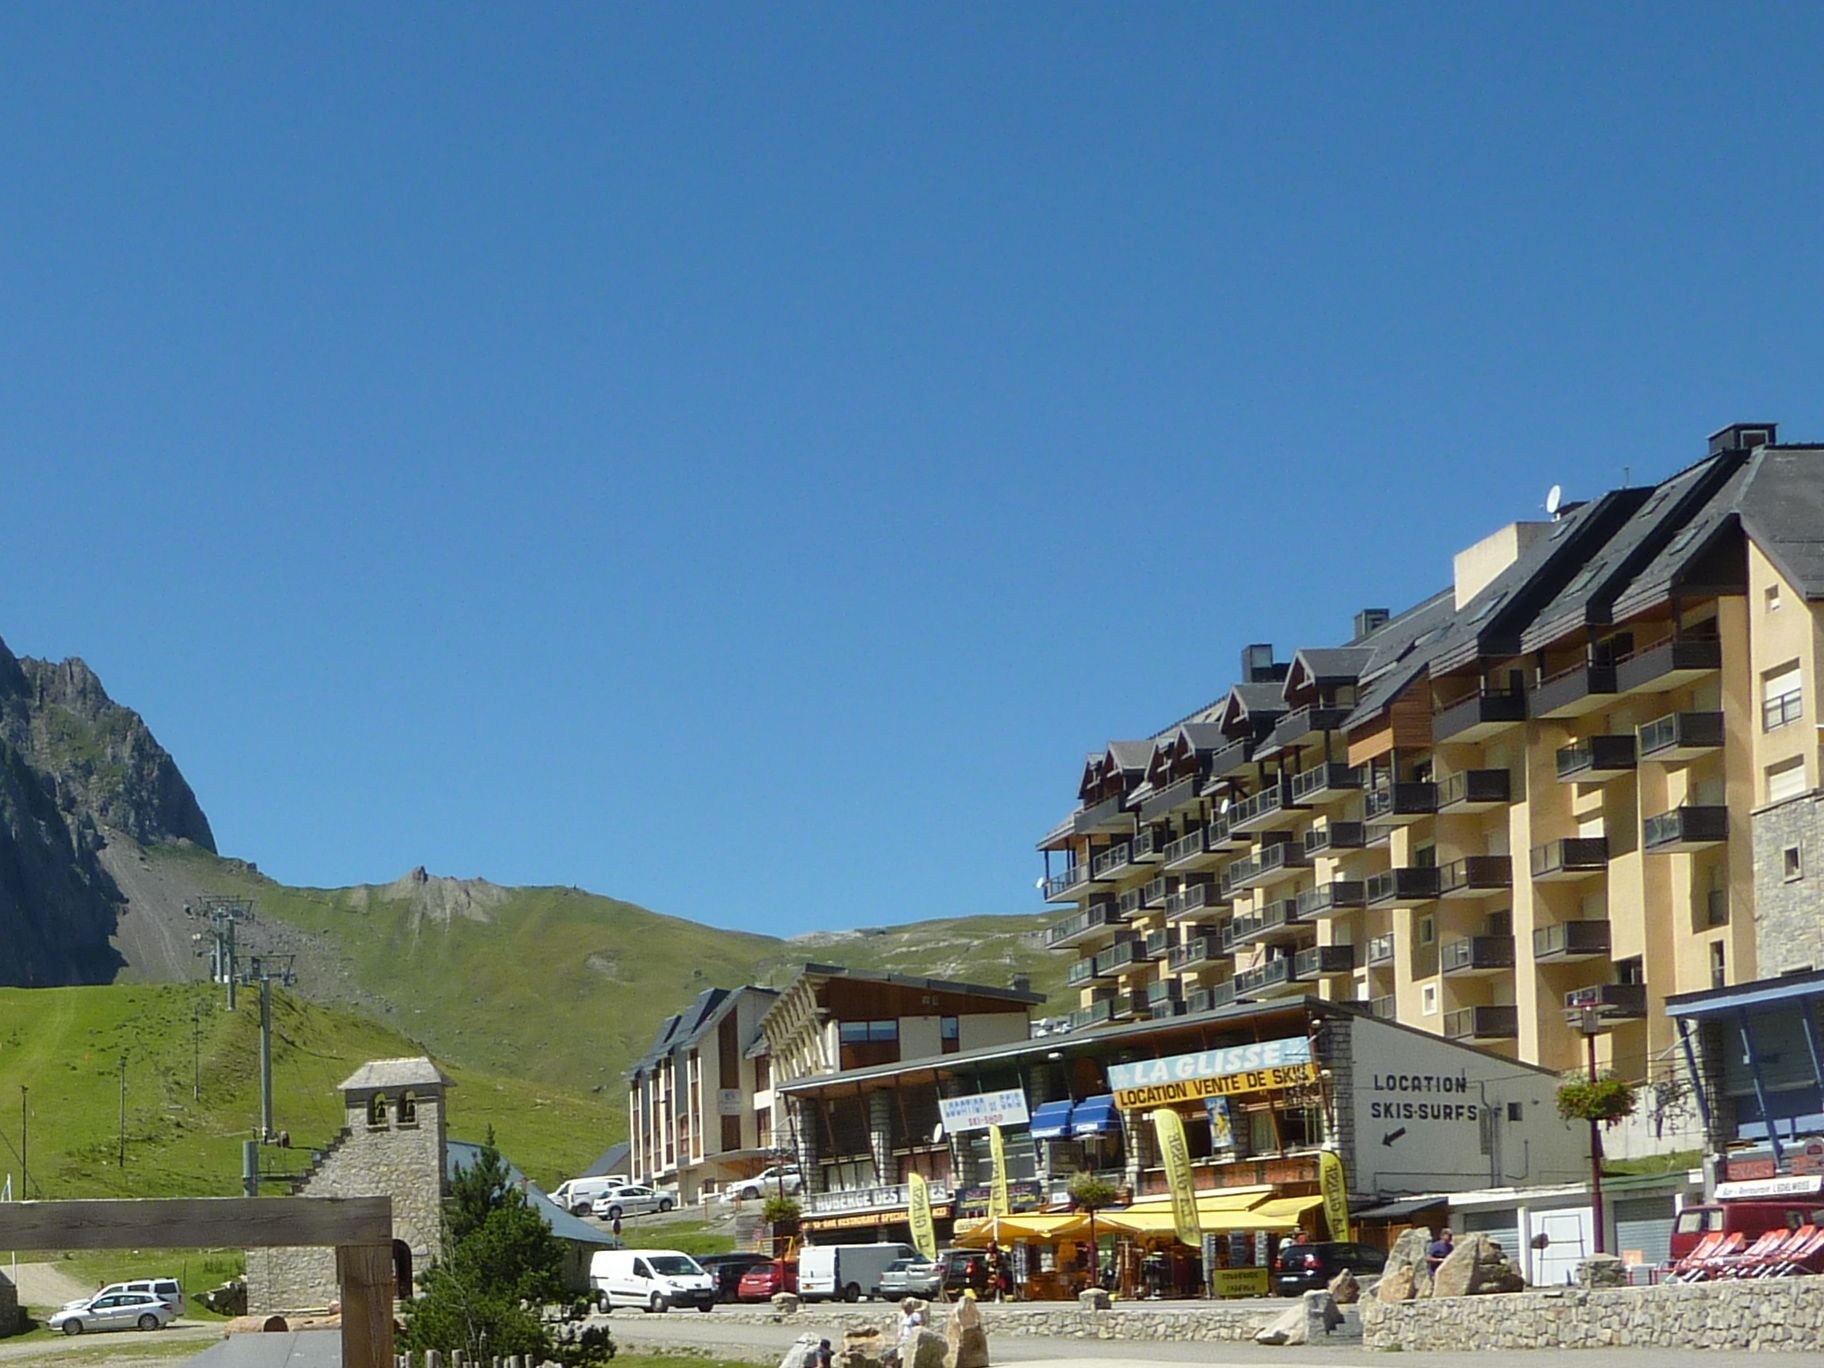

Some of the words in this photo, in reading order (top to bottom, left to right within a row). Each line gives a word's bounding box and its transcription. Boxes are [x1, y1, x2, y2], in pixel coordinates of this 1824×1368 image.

[1133, 1060, 1169, 1084] LA
[1176, 1043, 1281, 1078] GLISSE
[1119, 1082, 1188, 1106] LOCATION
[1194, 1075, 1241, 1095] VENTE
[1247, 1071, 1267, 1088] DE
[1374, 1074, 1466, 1093] LOCATION
[873, 1186, 898, 1206] DES
